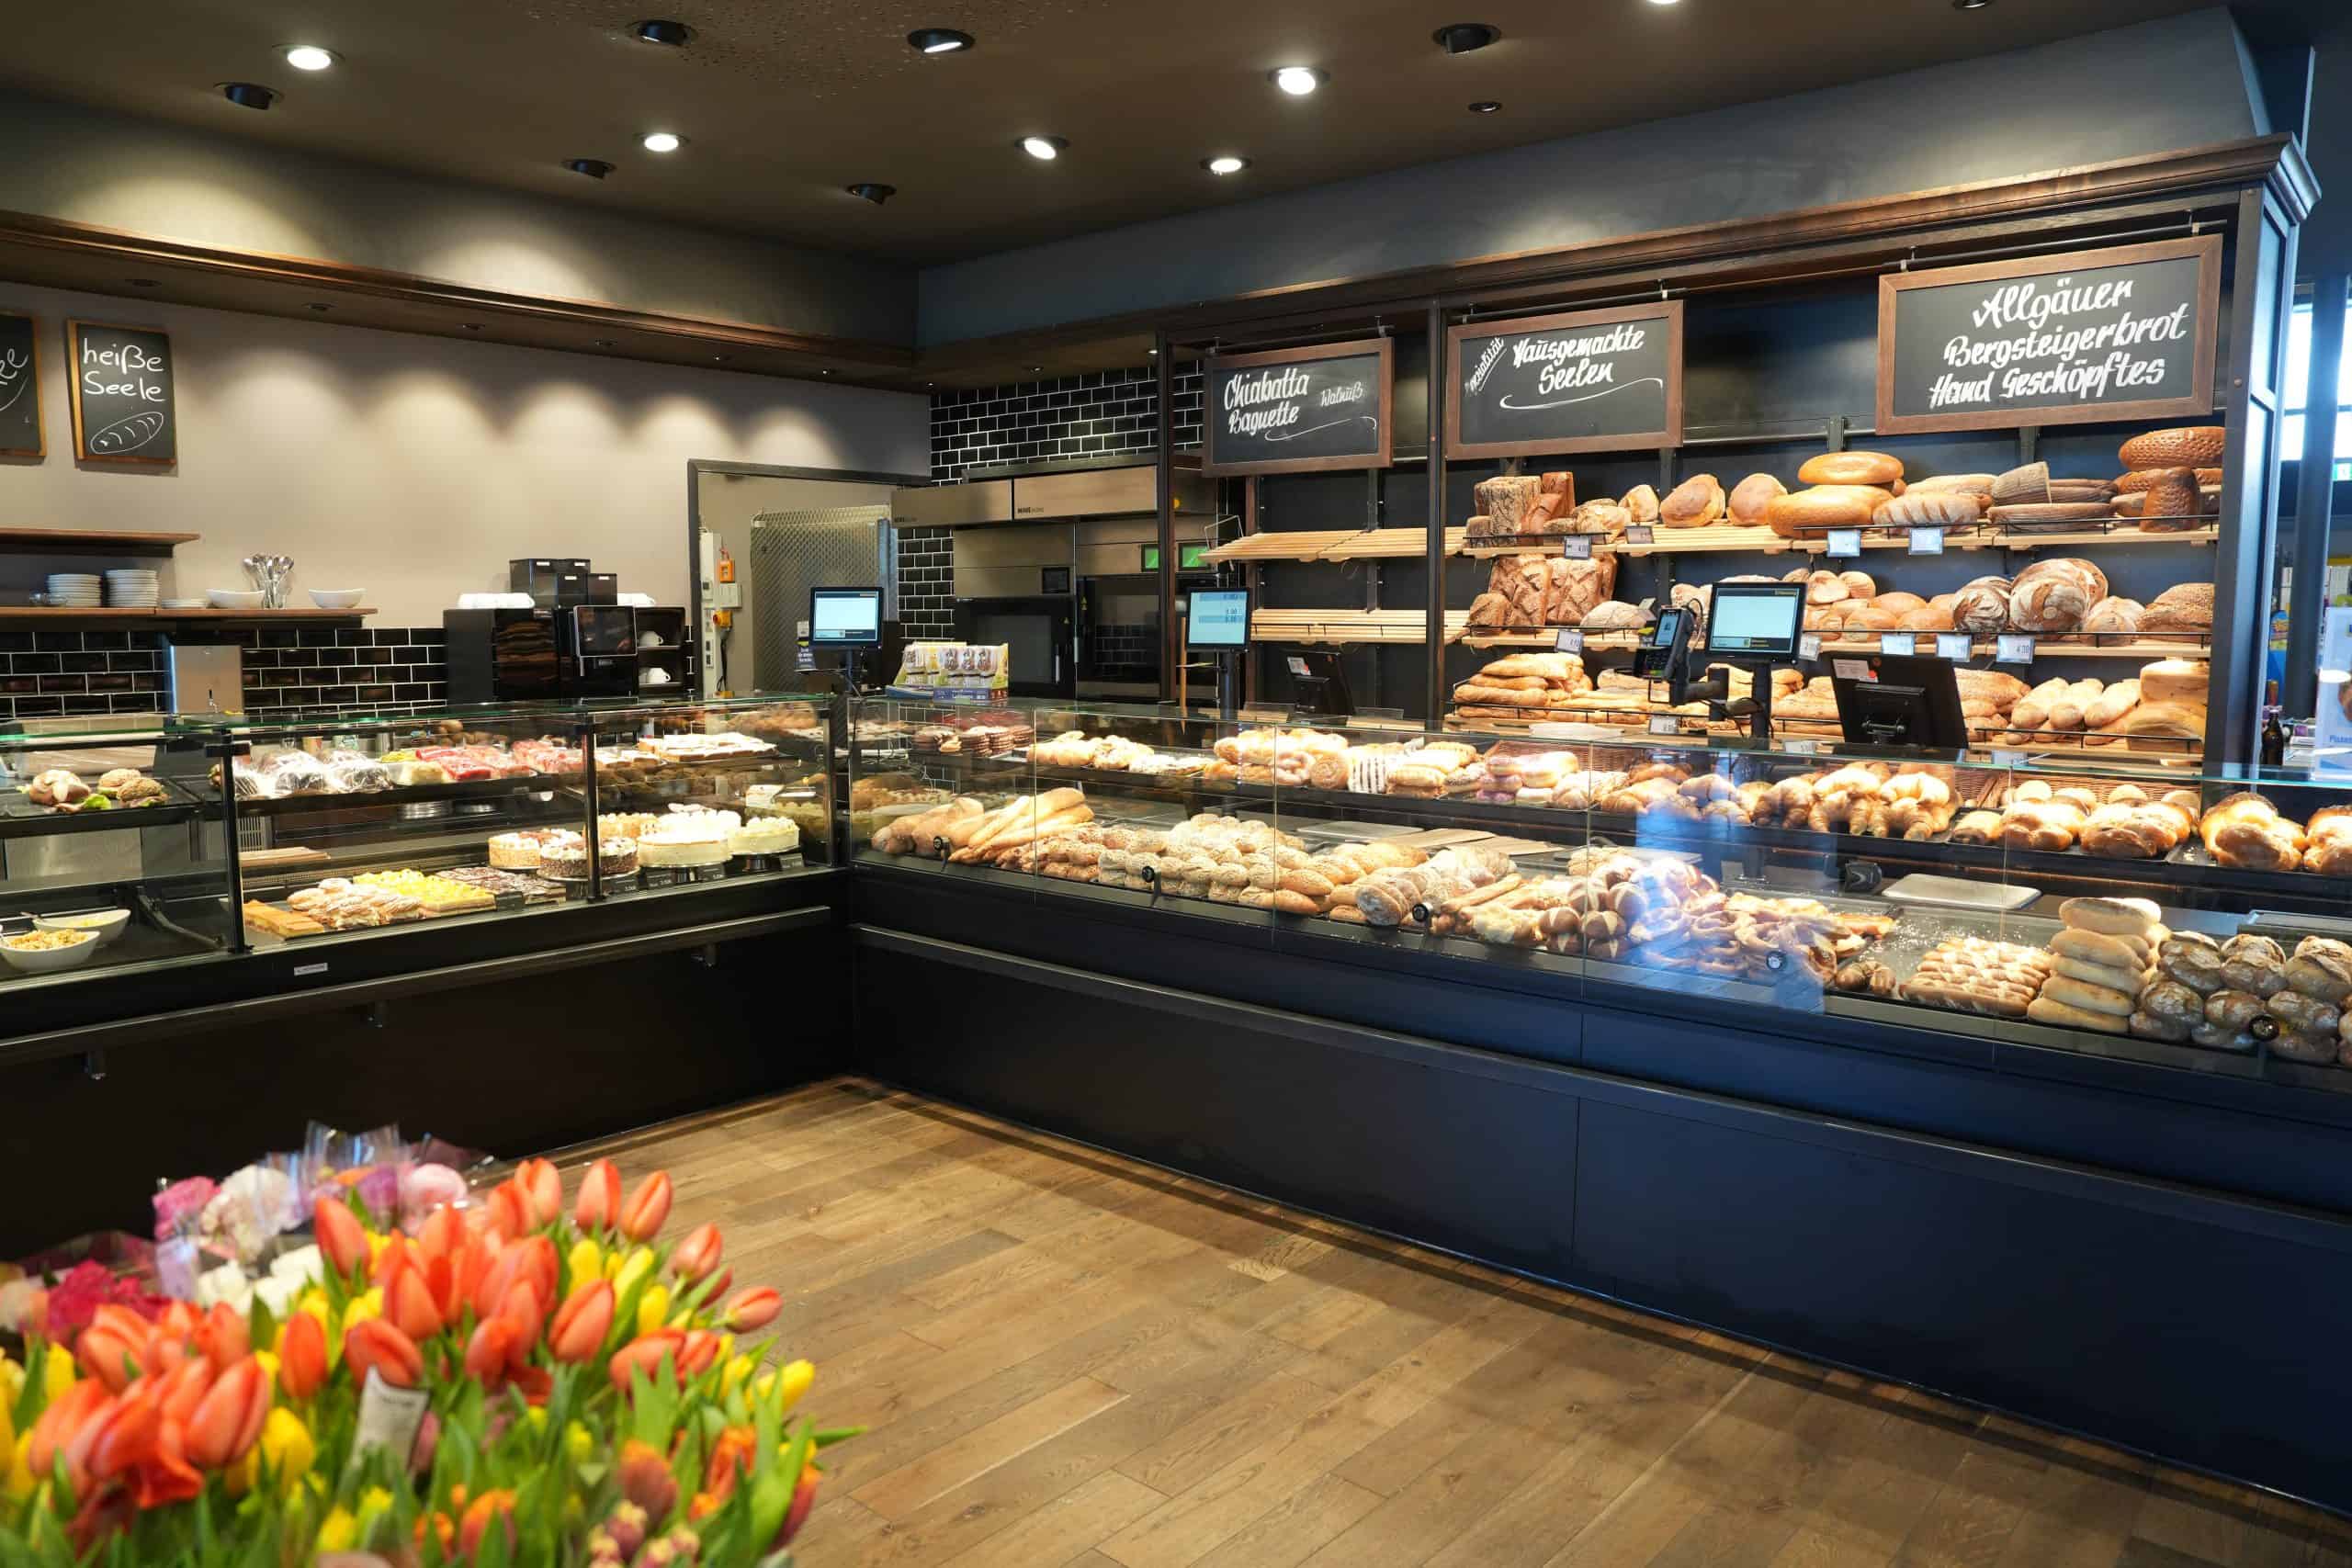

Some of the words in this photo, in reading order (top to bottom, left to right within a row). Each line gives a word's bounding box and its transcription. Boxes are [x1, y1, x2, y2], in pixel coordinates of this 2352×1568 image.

[1973, 277, 2134, 330] Allgäuer
[83, 337, 164, 375] heiße
[1512, 324, 1645, 368] Hausgemachte
[1943, 303, 2190, 368] Bergsteigerbrot
[84, 370, 166, 402] Seele
[1224, 367, 1311, 411] Chiabatta
[1538, 358, 1614, 395] Seelen
[1929, 371, 1995, 409] Hand
[1998, 351, 2165, 399] Geschöpftes
[1227, 400, 1301, 436] Baguette
